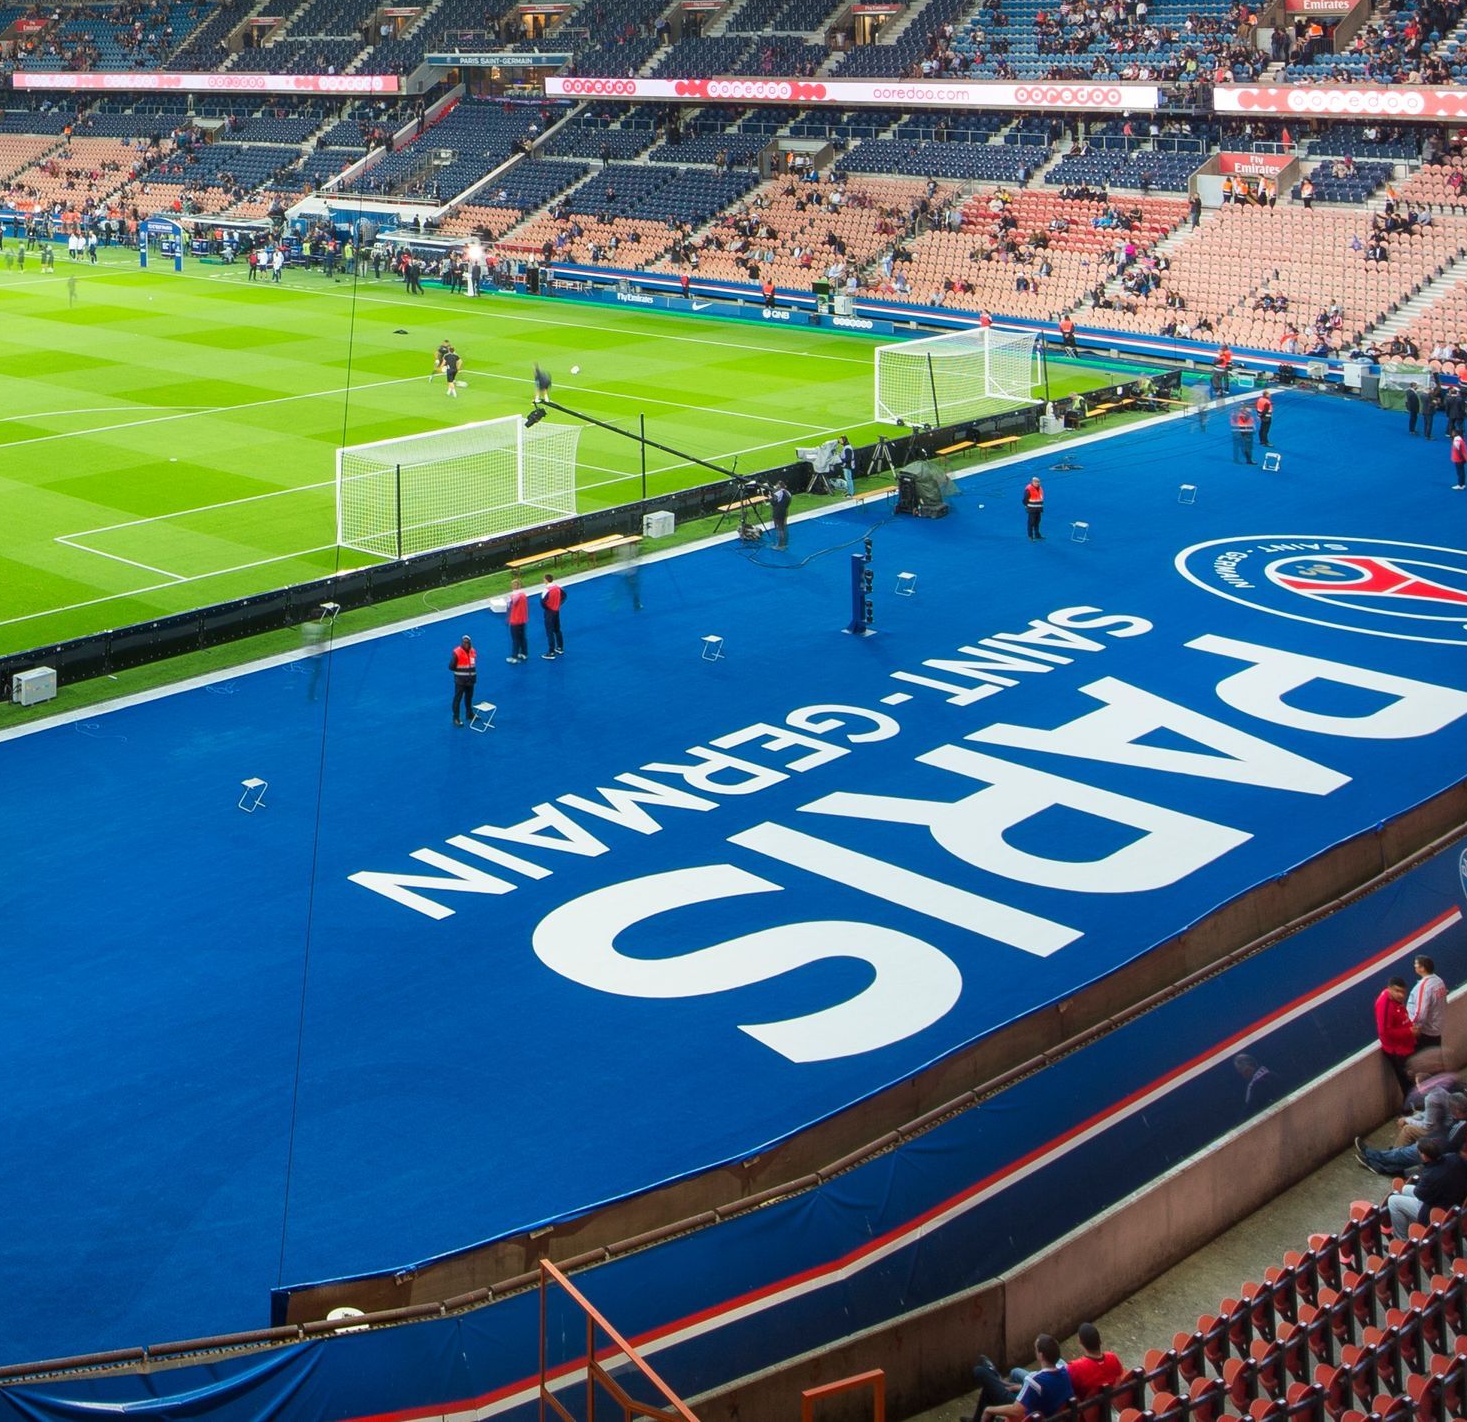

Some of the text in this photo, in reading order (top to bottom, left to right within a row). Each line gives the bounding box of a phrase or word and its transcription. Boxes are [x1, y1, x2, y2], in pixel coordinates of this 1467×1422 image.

[1303, 0, 1350, 10] Emirates
[460, 57, 480, 65] PARIS
[564, 80, 635, 94] ooredoo
[710, 82, 789, 97] ooredoo
[873, 87, 970, 101] ooredoo.com
[1017, 87, 1119, 105] ooredoo
[1250, 155, 1264, 165] Fly
[1235, 163, 1280, 175] Emirates
[772, 311, 790, 320] QNB
